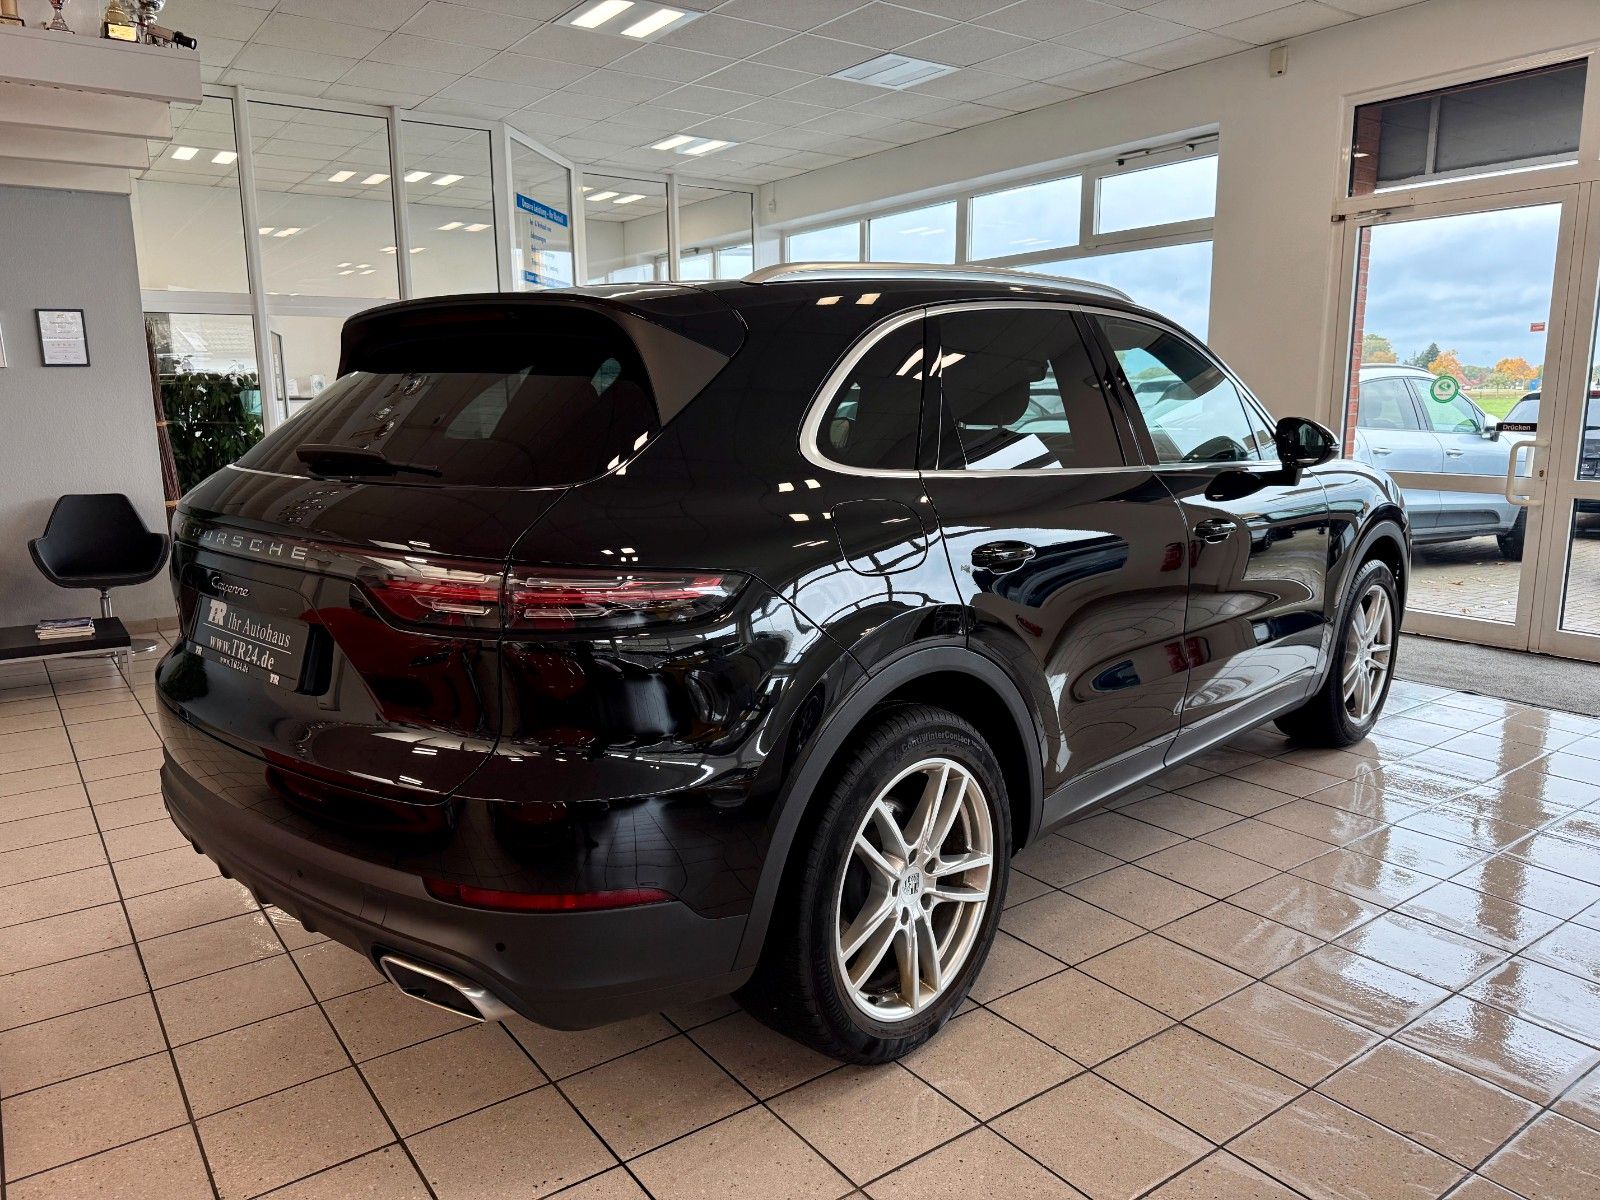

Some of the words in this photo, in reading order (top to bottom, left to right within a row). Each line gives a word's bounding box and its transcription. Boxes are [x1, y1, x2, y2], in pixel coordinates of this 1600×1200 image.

[211, 576, 250, 597] Cayenne
[227, 612, 242, 632] Ihr
[242, 618, 291, 648] Autohaus
[210, 635, 275, 670] www.TR24.de
